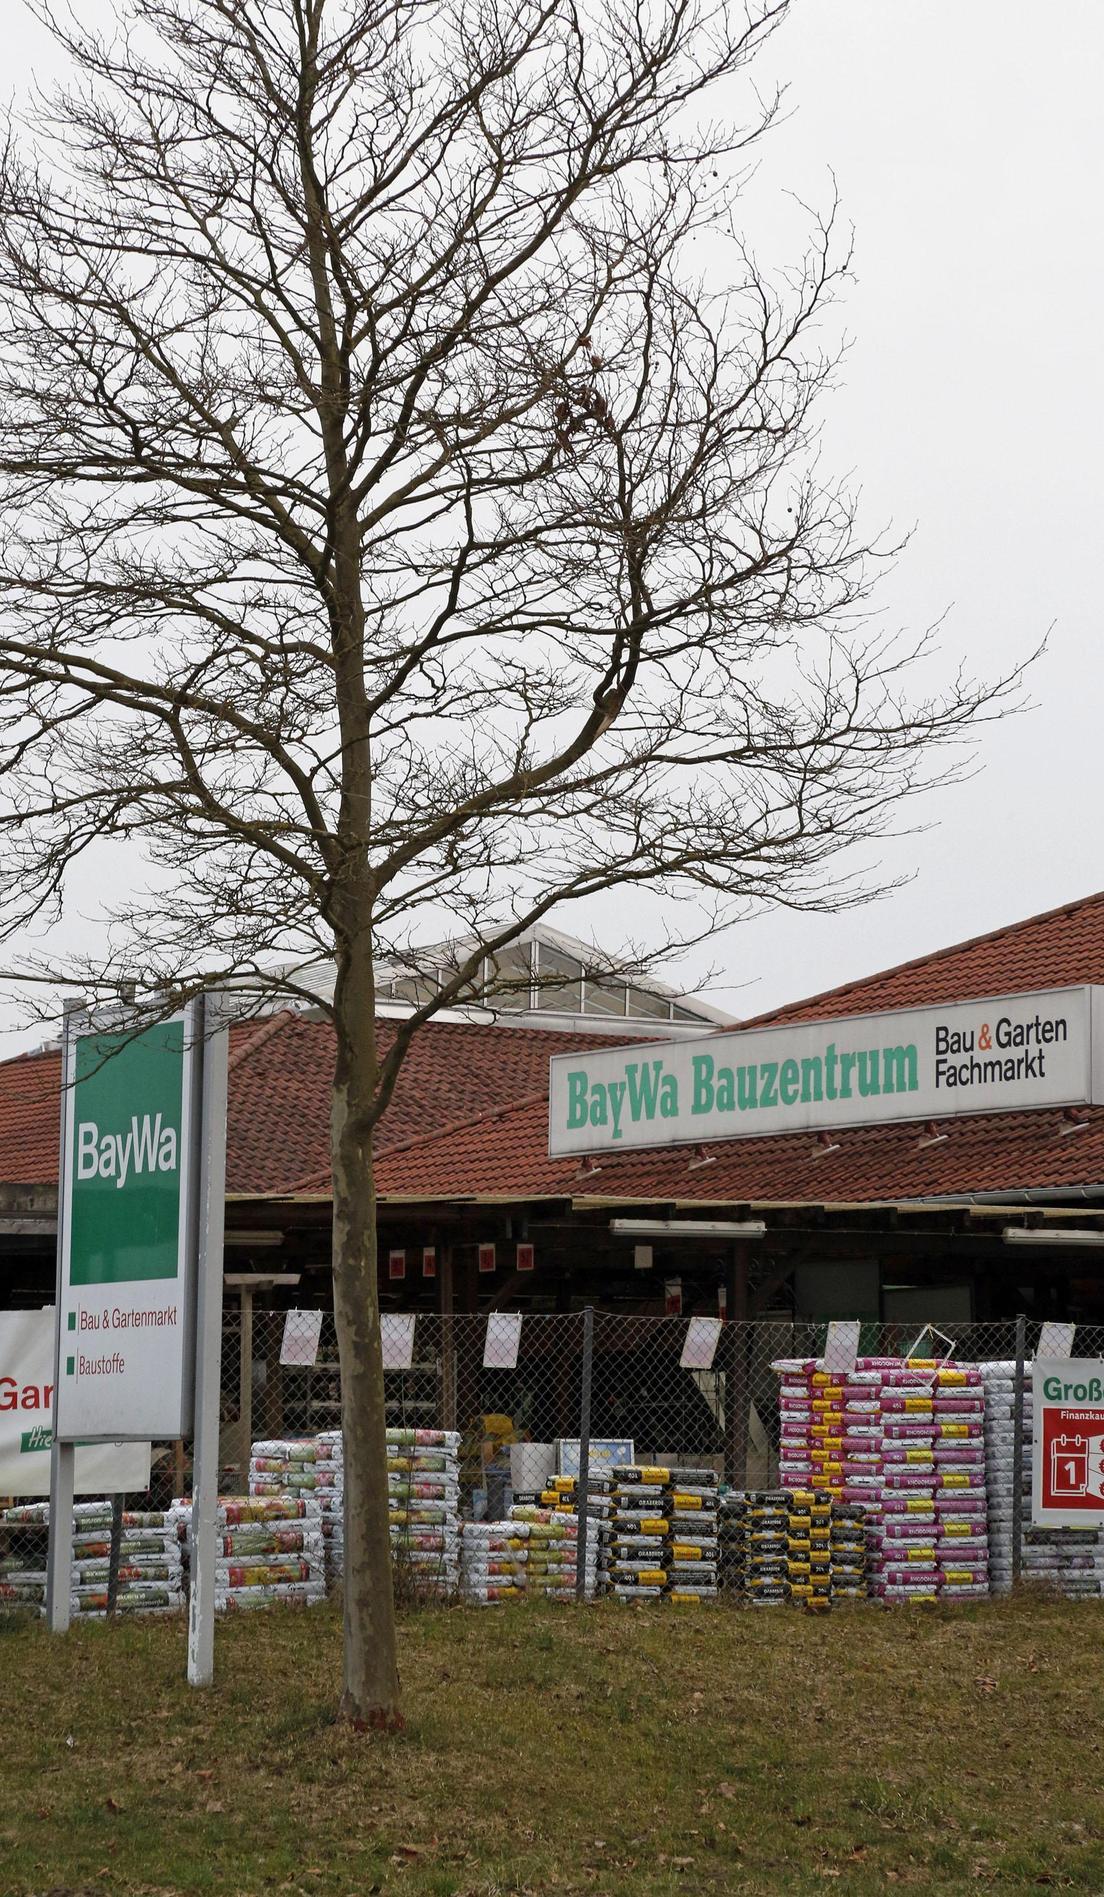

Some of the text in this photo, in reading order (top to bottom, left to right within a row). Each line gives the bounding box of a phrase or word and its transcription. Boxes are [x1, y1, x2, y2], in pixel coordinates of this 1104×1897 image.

[936, 1015, 1067, 1055] Bau & Garten
[936, 1048, 1045, 1088] Fachmarkt
[566, 1043, 919, 1139] BayWa Bauzentrum
[78, 1113, 176, 1188] BayWa
[80, 1306, 177, 1330] Bau & Gartenmarkt
[79, 1352, 125, 1375] Baustoffe
[1043, 1377, 1104, 1401] Groß
[1064, 1461, 1076, 1485] 1
